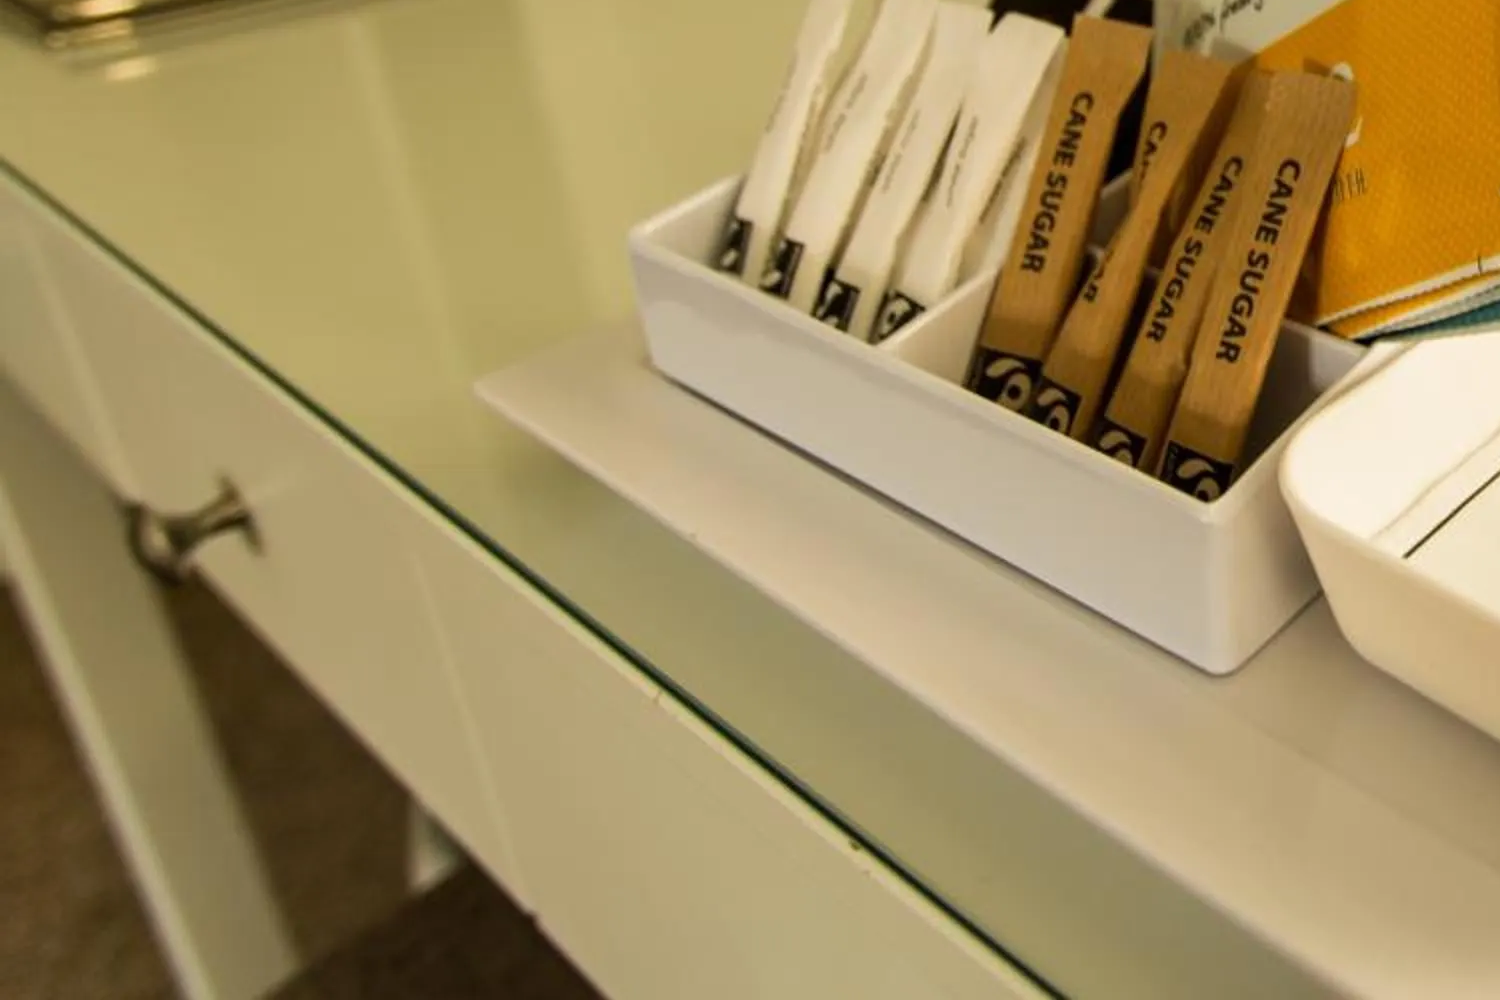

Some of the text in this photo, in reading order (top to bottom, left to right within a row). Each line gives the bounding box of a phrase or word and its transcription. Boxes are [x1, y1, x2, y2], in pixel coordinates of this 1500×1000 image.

[1020, 90, 1095, 274] CANE SUGAR
[1126, 155, 1244, 343] CANE SUGAR
[1215, 157, 1301, 364] CANE SUGAR
